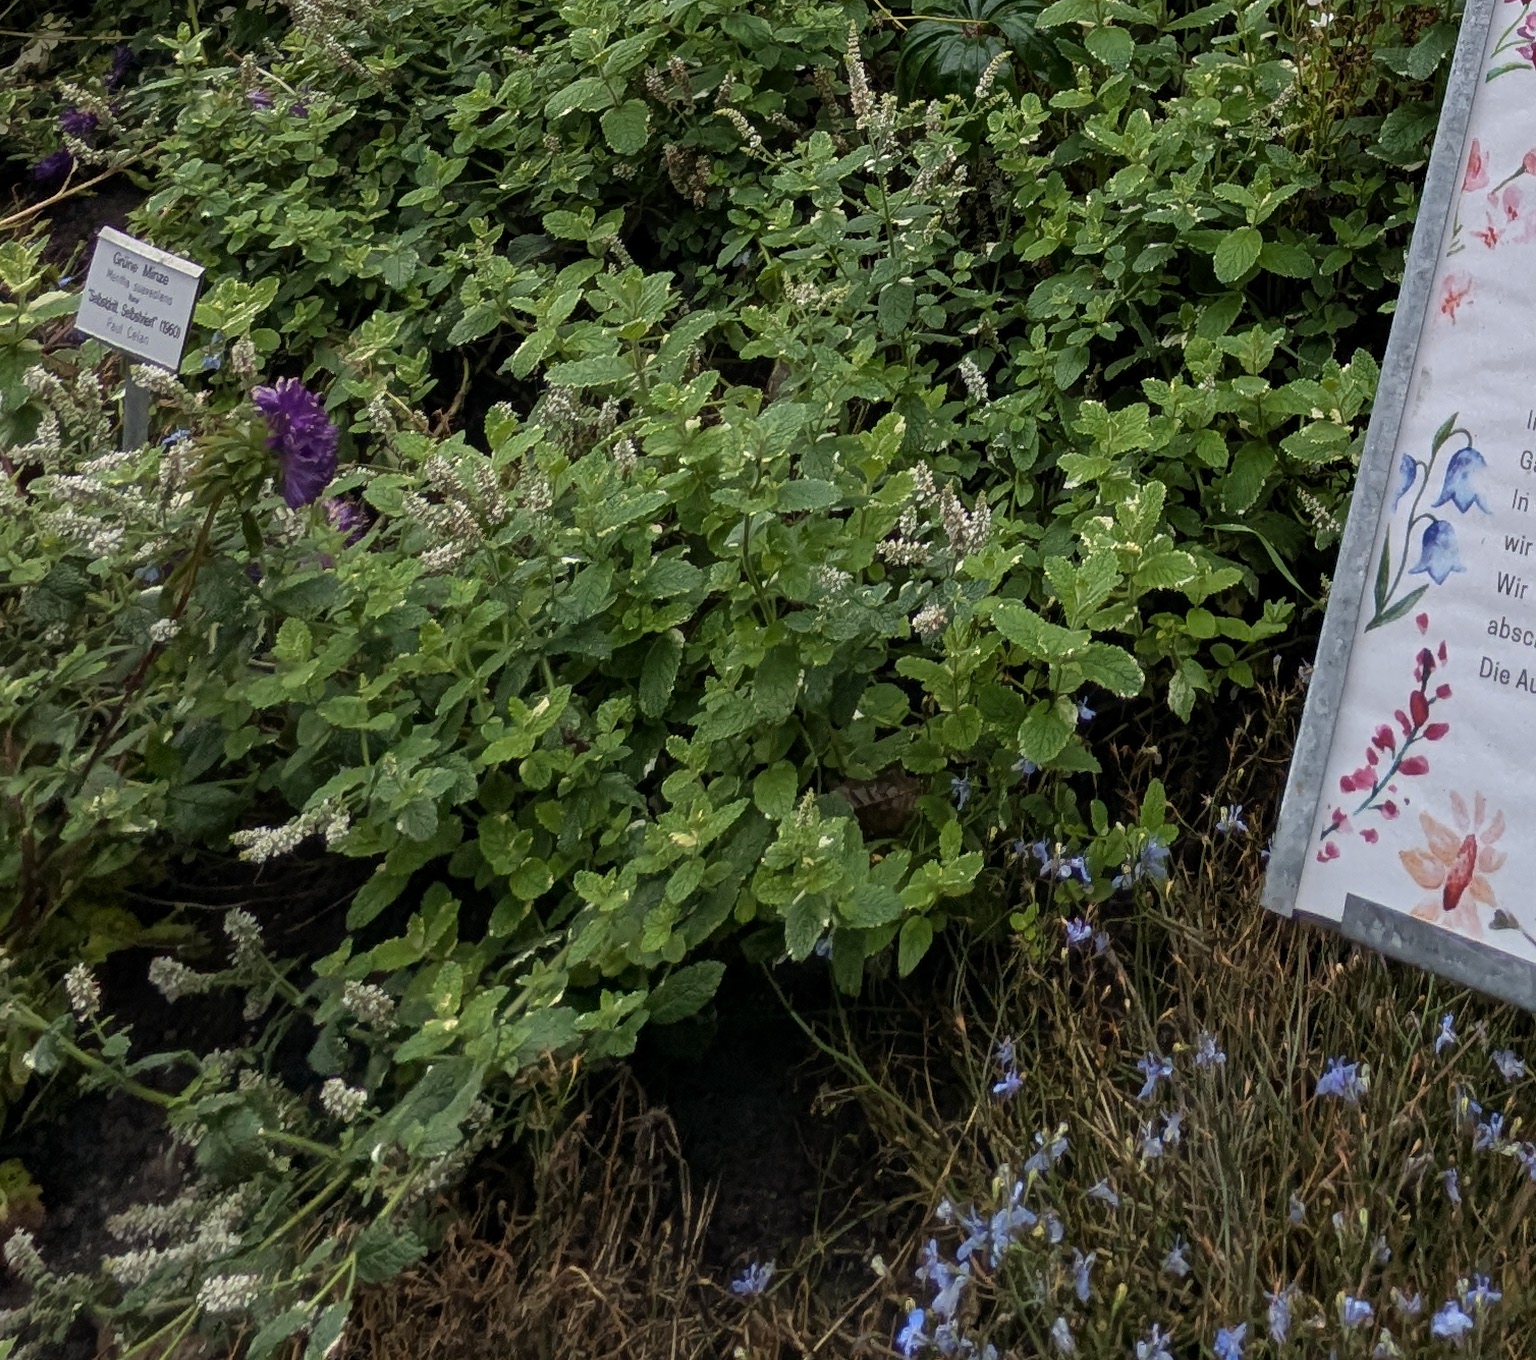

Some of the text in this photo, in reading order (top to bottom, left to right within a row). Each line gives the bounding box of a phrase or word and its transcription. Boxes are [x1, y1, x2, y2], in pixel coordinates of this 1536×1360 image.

[113, 252, 170, 285] Grüne Minze
[1511, 488, 1530, 513] In
[1478, 655, 1511, 686] Die
